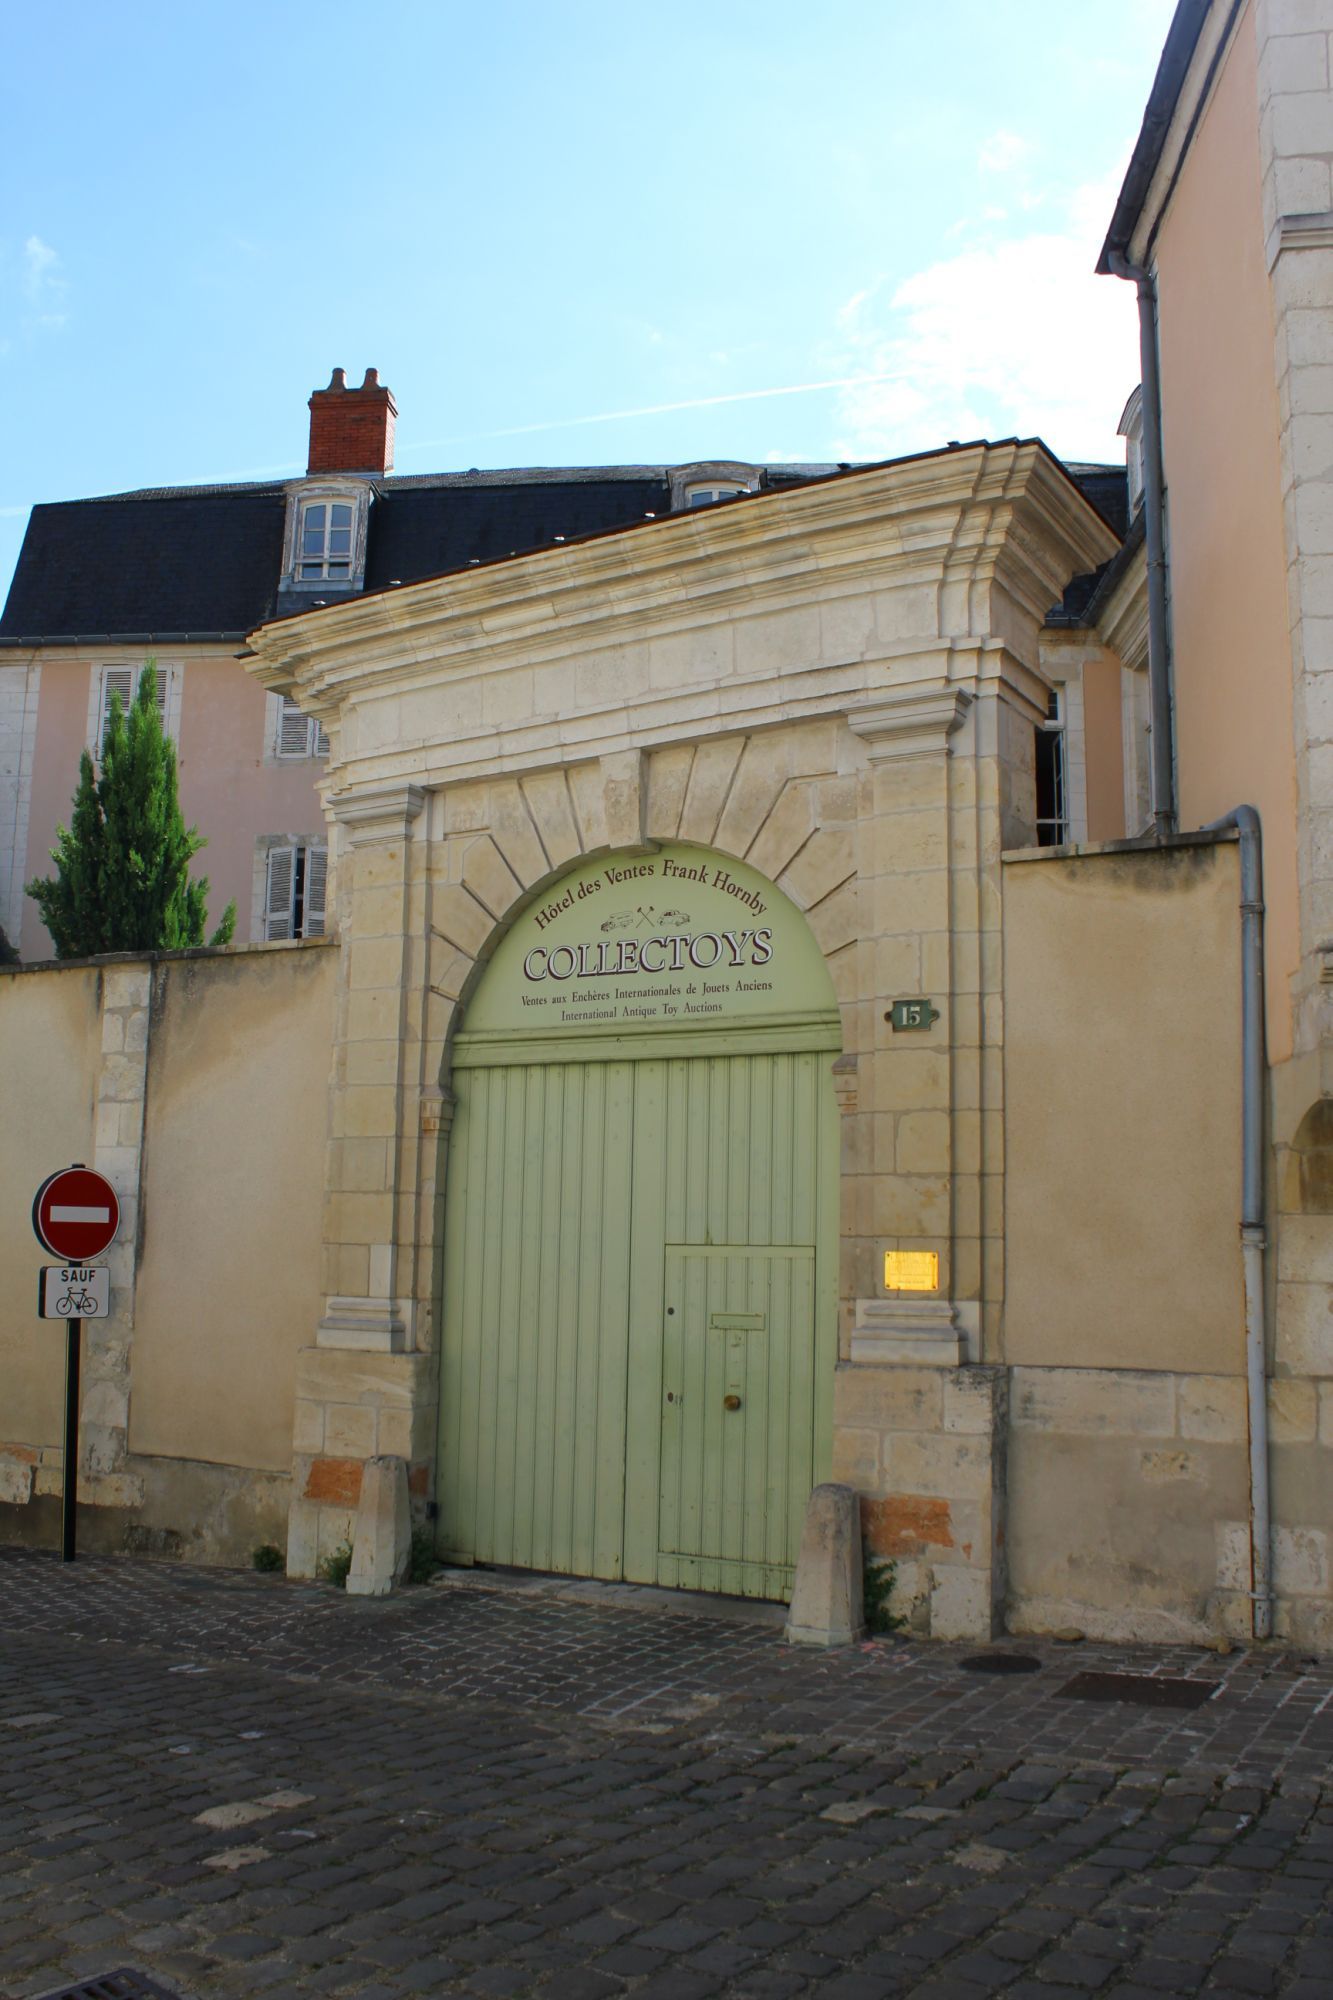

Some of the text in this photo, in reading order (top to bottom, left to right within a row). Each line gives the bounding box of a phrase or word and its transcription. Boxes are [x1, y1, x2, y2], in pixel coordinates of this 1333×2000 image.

[534, 859, 767, 930] Hôtel des Ventes Frank Hornby
[523, 927, 774, 981] COLLECTOYS
[521, 995, 547, 1006] Ventes
[552, 996, 567, 1004] aux
[615, 984, 681, 999] Internationales
[686, 983, 697, 994] de
[702, 982, 730, 996] Jouets
[735, 979, 773, 992] Anciens
[561, 1001, 722, 1021] International Antique Toy Auctions
[901, 1006, 921, 1025] 15
[61, 1269, 96, 1282] SAUF
